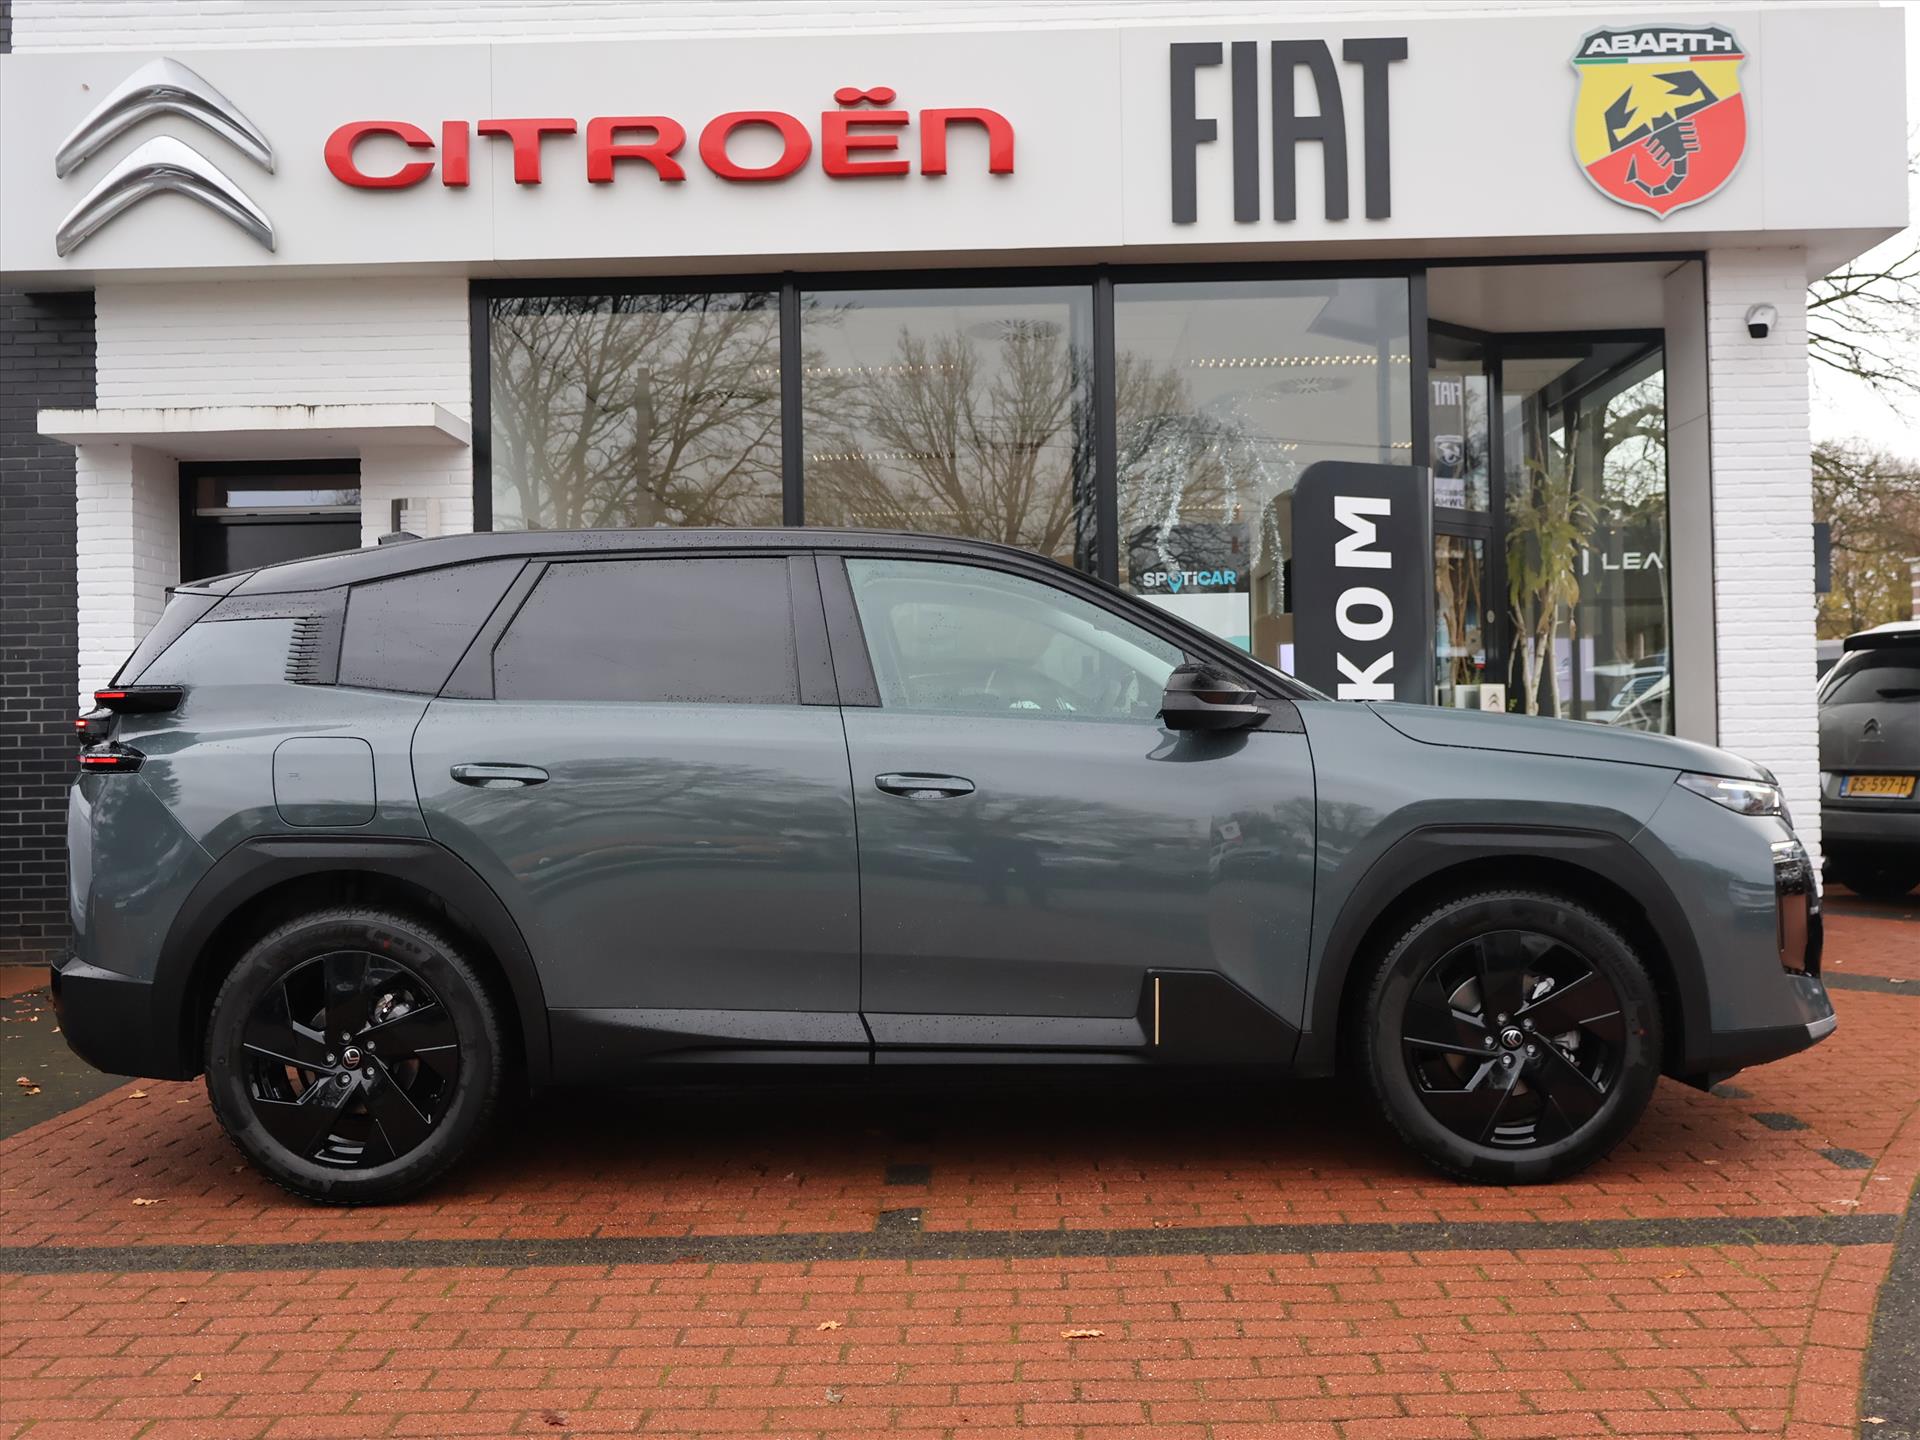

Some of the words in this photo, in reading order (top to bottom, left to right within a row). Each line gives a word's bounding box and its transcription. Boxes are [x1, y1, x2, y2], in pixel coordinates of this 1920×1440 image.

[1585, 32, 1732, 55] ABARTH
[324, 86, 1015, 189] CITROËN
[1170, 37, 1408, 225] FIAT
[1334, 495, 1394, 700] KOM
